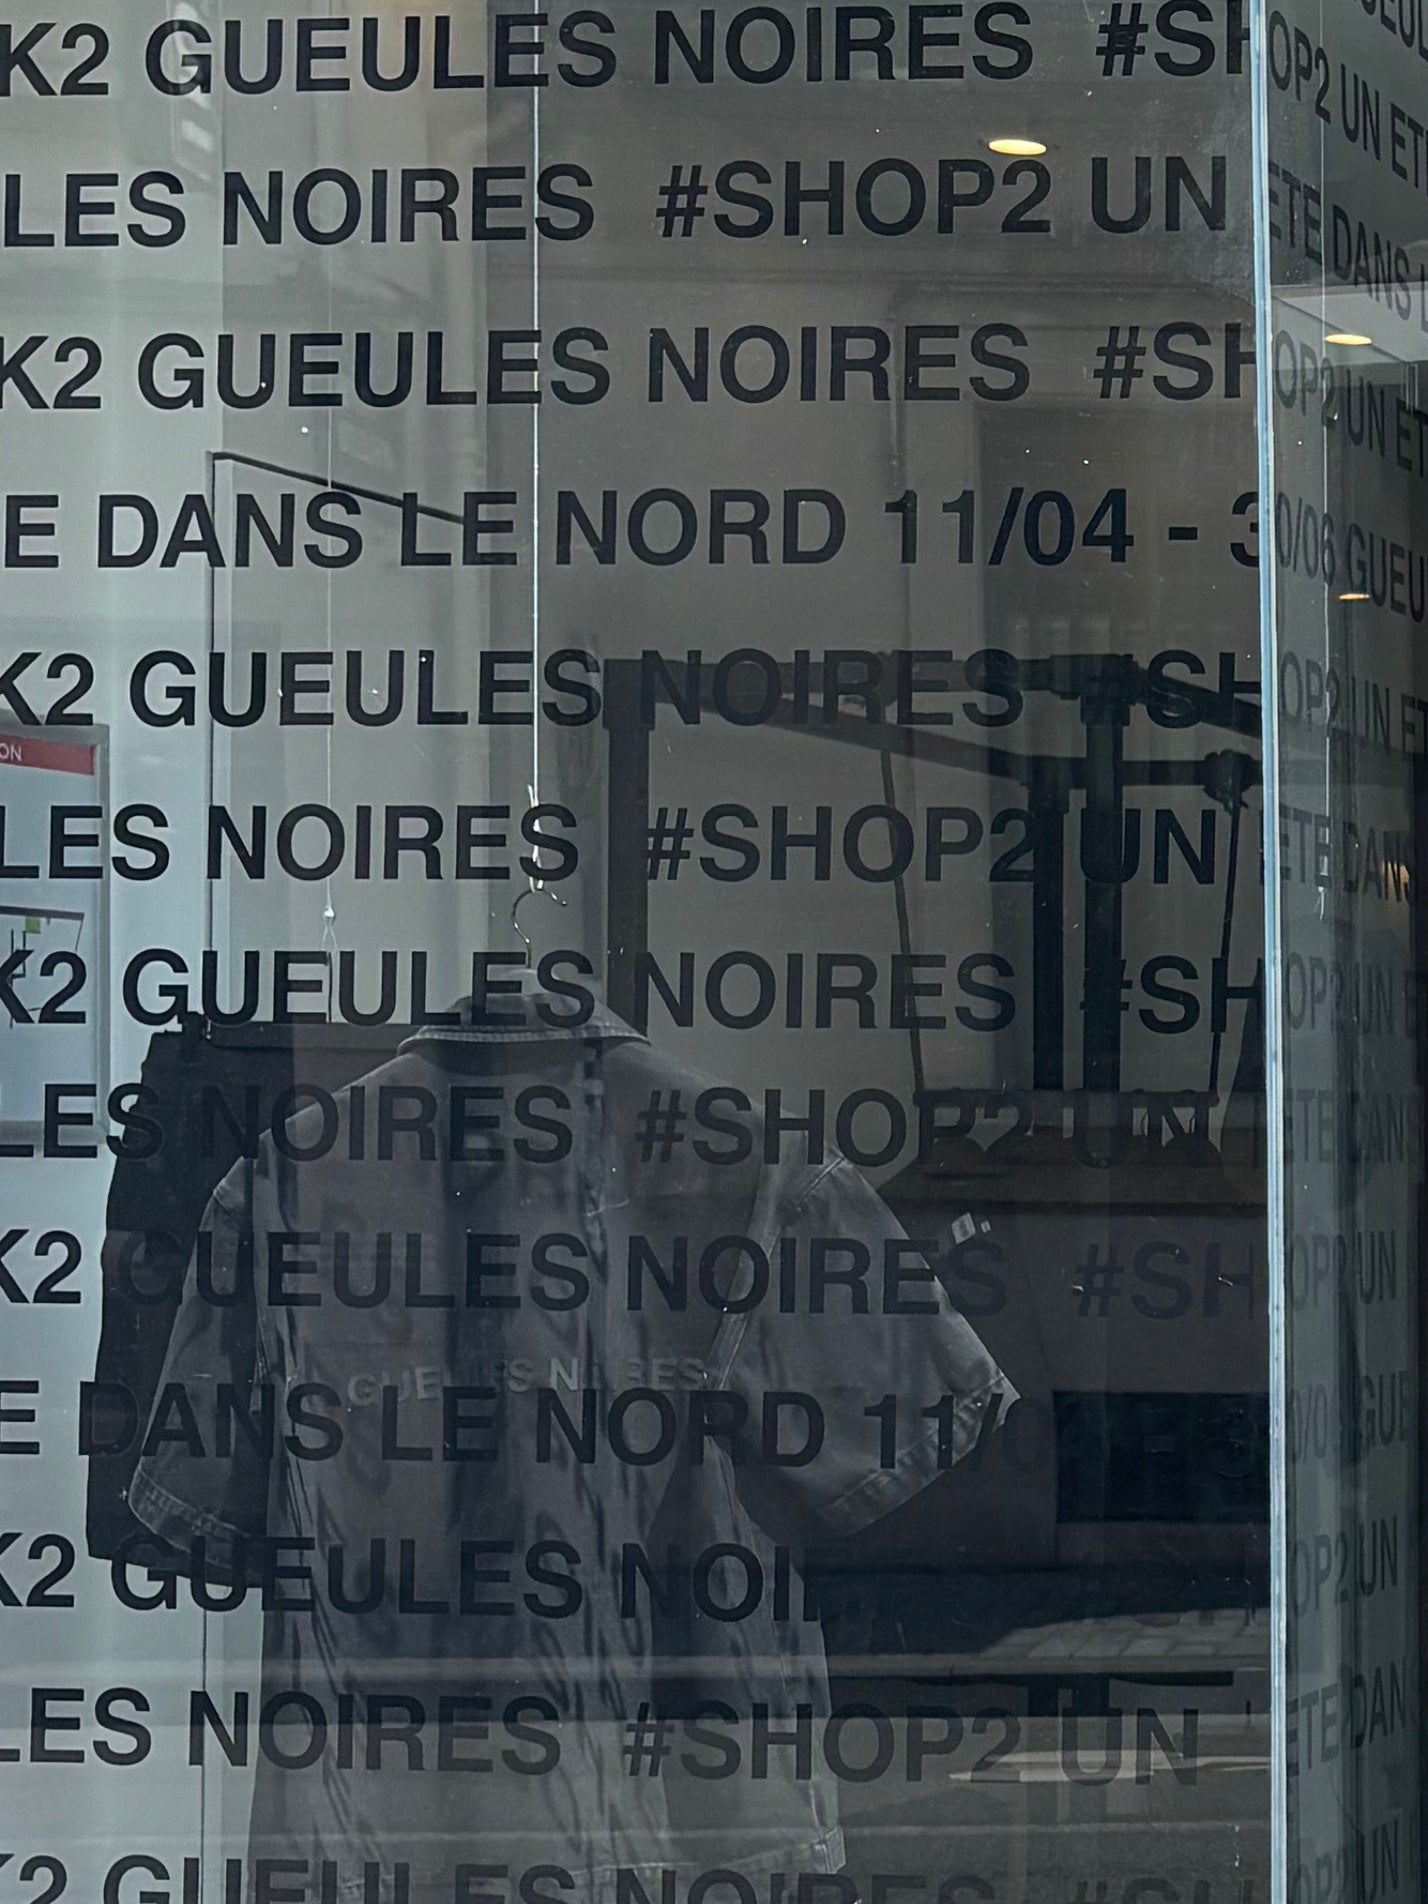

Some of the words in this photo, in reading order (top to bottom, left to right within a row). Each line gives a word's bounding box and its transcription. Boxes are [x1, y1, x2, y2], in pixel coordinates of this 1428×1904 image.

[145, 10, 617, 96] GUEULES
[655, 3, 1033, 84] NOIRES
[1268, 9, 1330, 125] OP2
[1341, 62, 1380, 165] UN
[223, 163, 594, 245] NOIRES
[656, 157, 1051, 238] #SHOP2
[1090, 156, 1226, 234] UN
[1332, 202, 1411, 319] DANS
[138, 327, 610, 410] GUEULES
[648, 322, 1030, 402] NOIRES
[1347, 379, 1386, 458] UN
[97, 491, 363, 569] DANS
[401, 491, 517, 566] LE
[556, 488, 846, 566] NORD
[884, 487, 1134, 566] 11/04
[130, 649, 602, 727] GUEULES
[641, 648, 1024, 727] NOIRES
[207, 804, 579, 881] NOIRES
[647, 804, 1036, 883] #SHOP2
[1079, 807, 1215, 884] UN
[123, 949, 595, 1027] GUEULES
[634, 951, 1015, 1031] NOIRES
[209, 1084, 573, 1162] NOIRES
[637, 1087, 1034, 1167] #SHOP2
[78, 1382, 345, 1460] DANS
[383, 1385, 498, 1462] LE
[536, 1387, 824, 1467] NORD
[111, 1534, 582, 1618] GUEULES
[189, 1691, 562, 1775] NOIRES
[623, 1700, 1021, 1783] #SHOP2
[1061, 1706, 1199, 1787] UN
